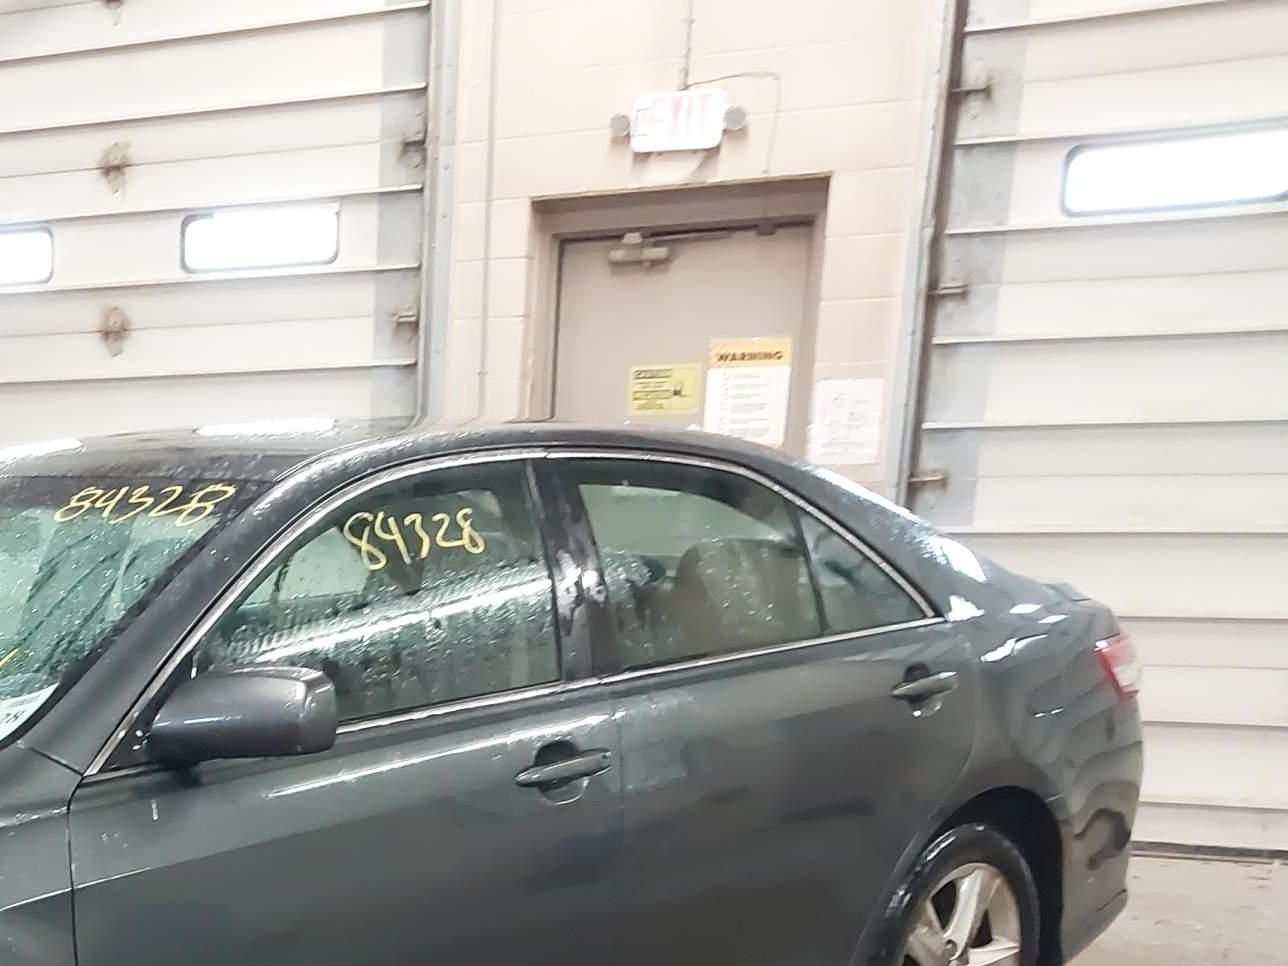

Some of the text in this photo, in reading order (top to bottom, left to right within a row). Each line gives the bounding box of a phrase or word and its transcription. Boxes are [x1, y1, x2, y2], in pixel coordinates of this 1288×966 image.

[646, 94, 712, 138] EXIT
[717, 351, 783, 363] WARNING
[54, 484, 237, 527] 84328
[343, 508, 485, 570] 84328
